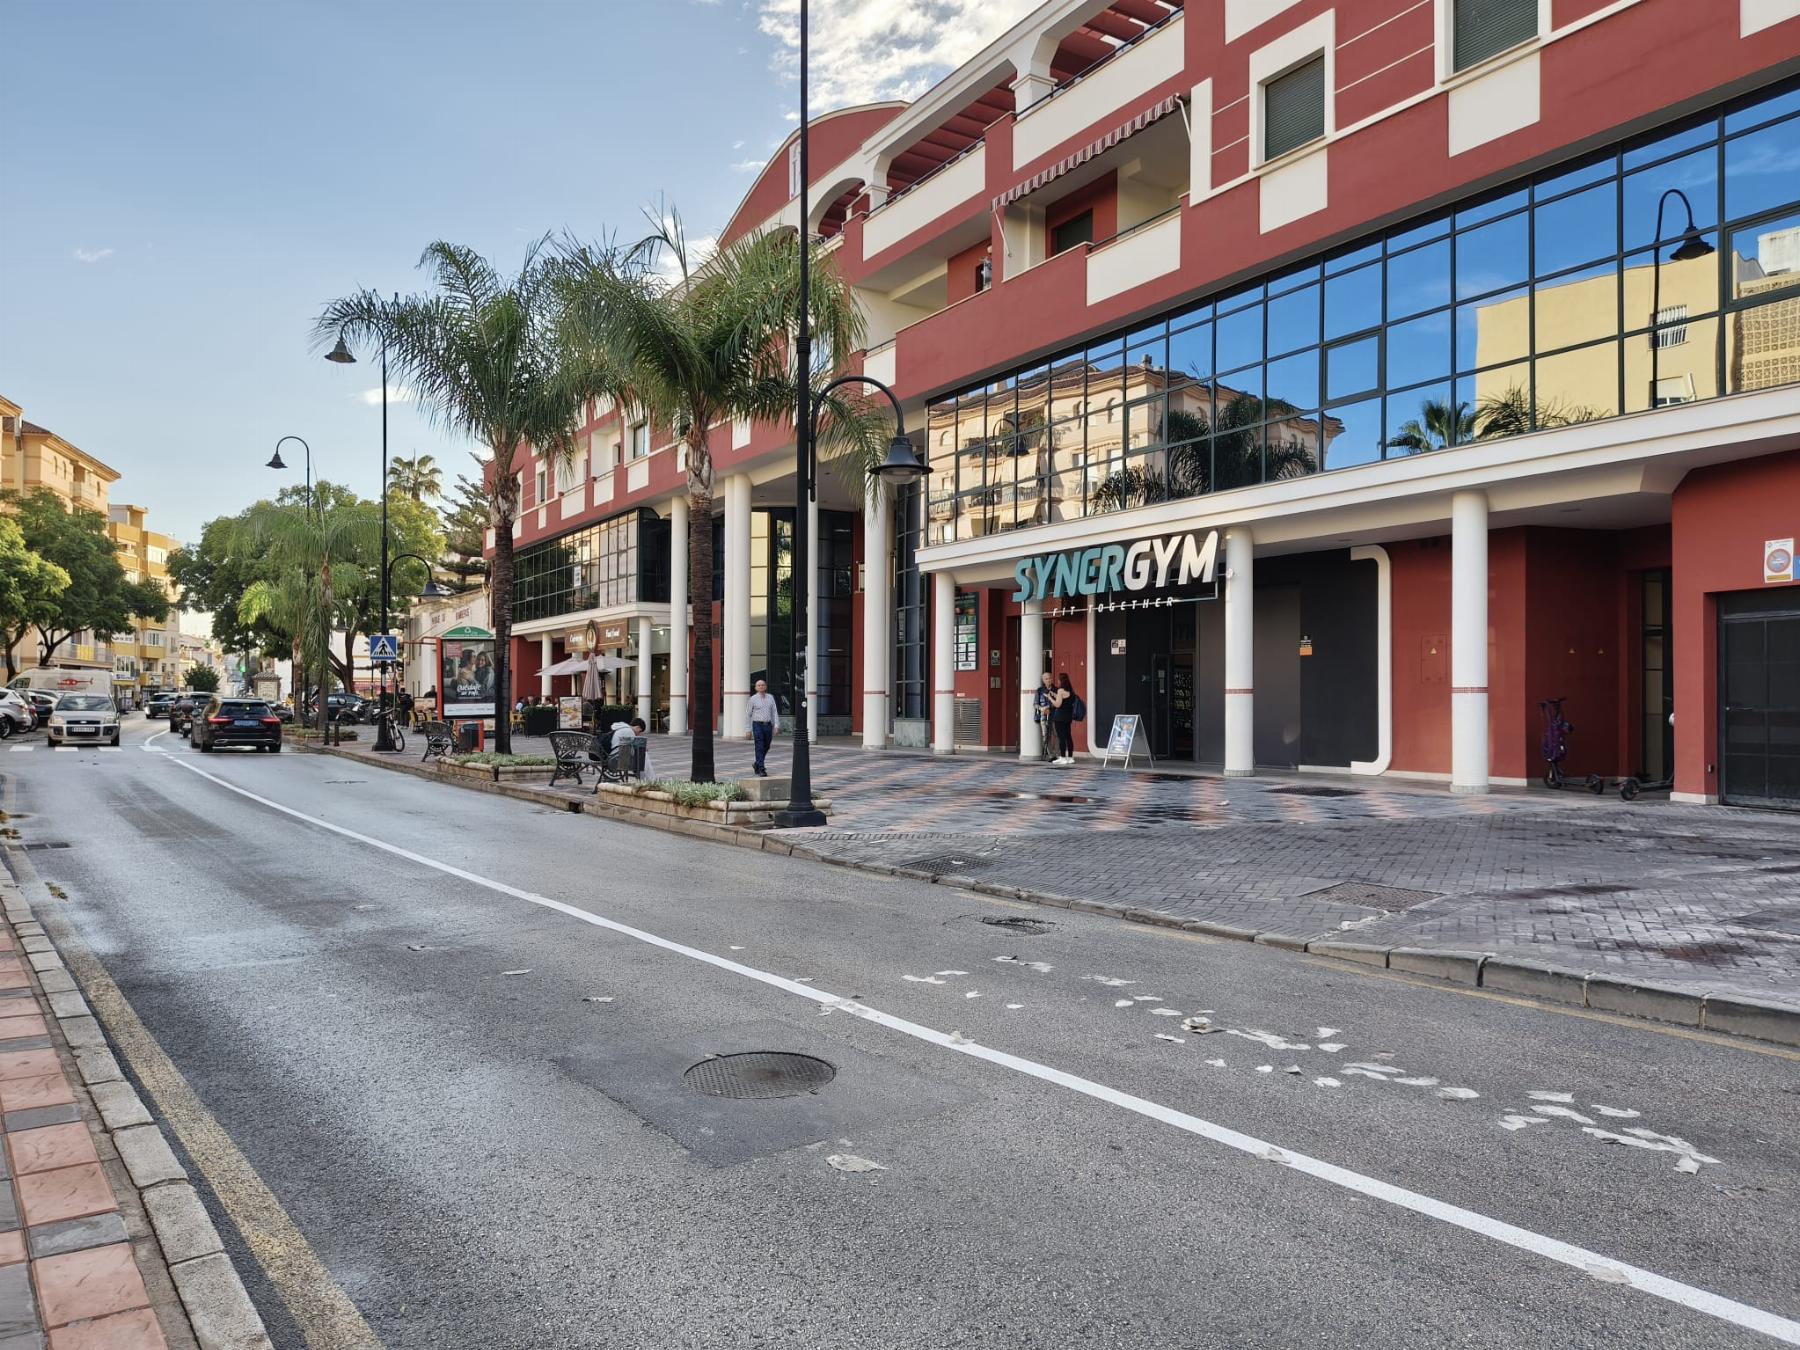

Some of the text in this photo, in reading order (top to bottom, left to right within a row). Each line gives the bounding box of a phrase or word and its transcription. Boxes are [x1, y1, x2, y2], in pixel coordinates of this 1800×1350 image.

[1012, 530, 1219, 603] SYNERGYM
[1052, 596, 1174, 617] FIT TOGETHER
